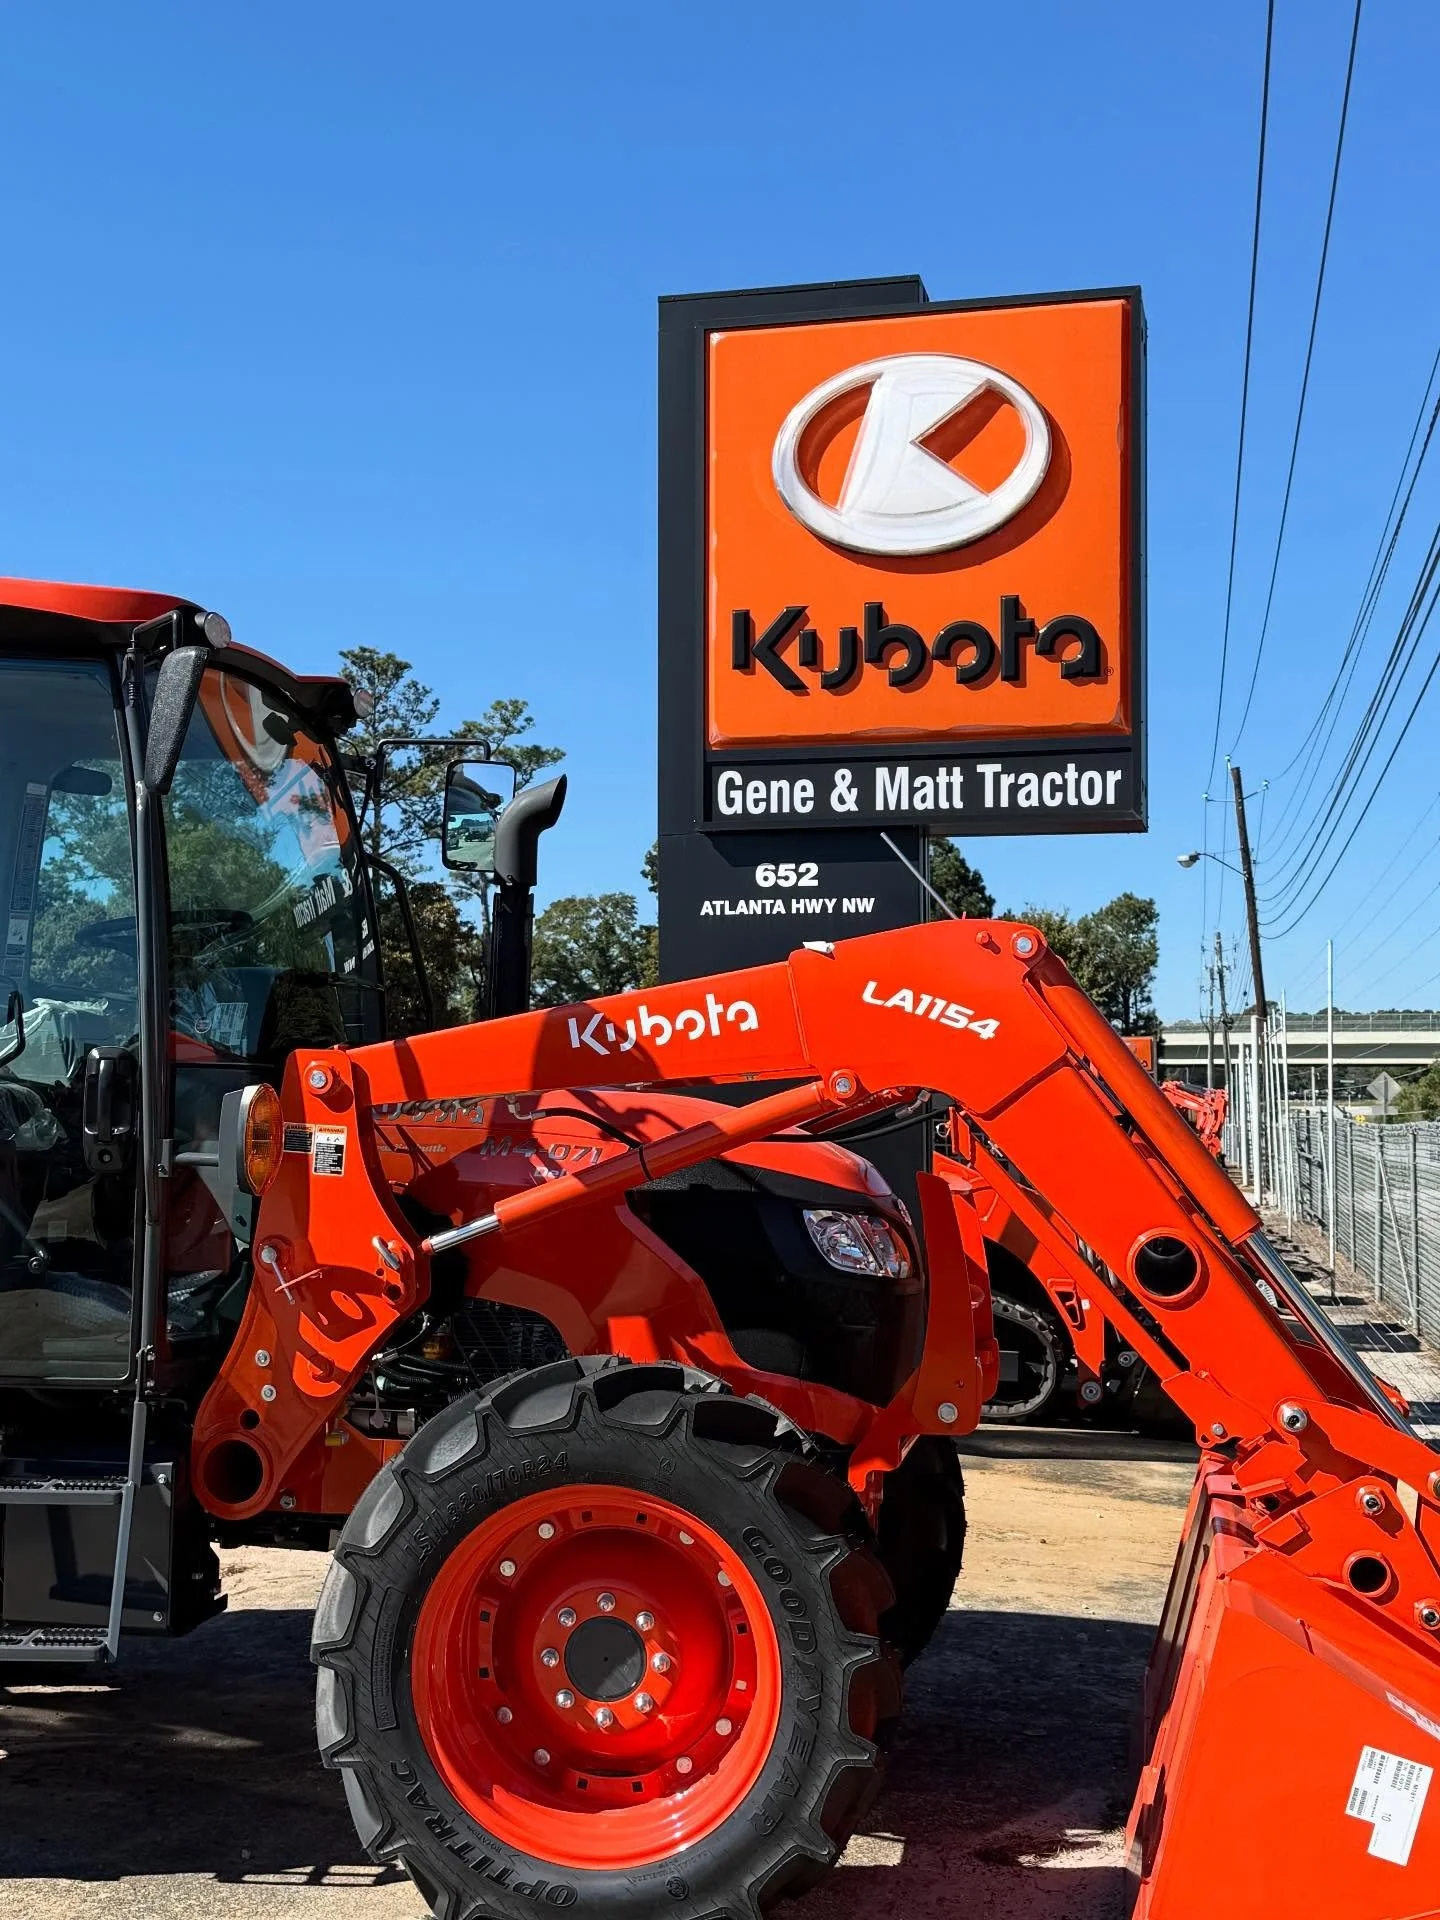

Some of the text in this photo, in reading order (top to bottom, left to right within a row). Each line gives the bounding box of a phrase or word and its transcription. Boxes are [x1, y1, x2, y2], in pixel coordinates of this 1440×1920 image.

[732, 594, 1100, 691] Kubota
[717, 762, 1122, 816] Gene & Matt Tractor
[755, 862, 819, 888] 652
[699, 897, 876, 917] ATLANTA HWY NW
[567, 993, 760, 1056] Kubota
[862, 980, 1001, 1040] LA1154
[479, 1136, 604, 1165] M4-071
[446, 1451, 569, 1523] 320/70R24
[742, 1526, 823, 1837] GOODYEAR
[390, 1758, 579, 1908] OPTITRAC
